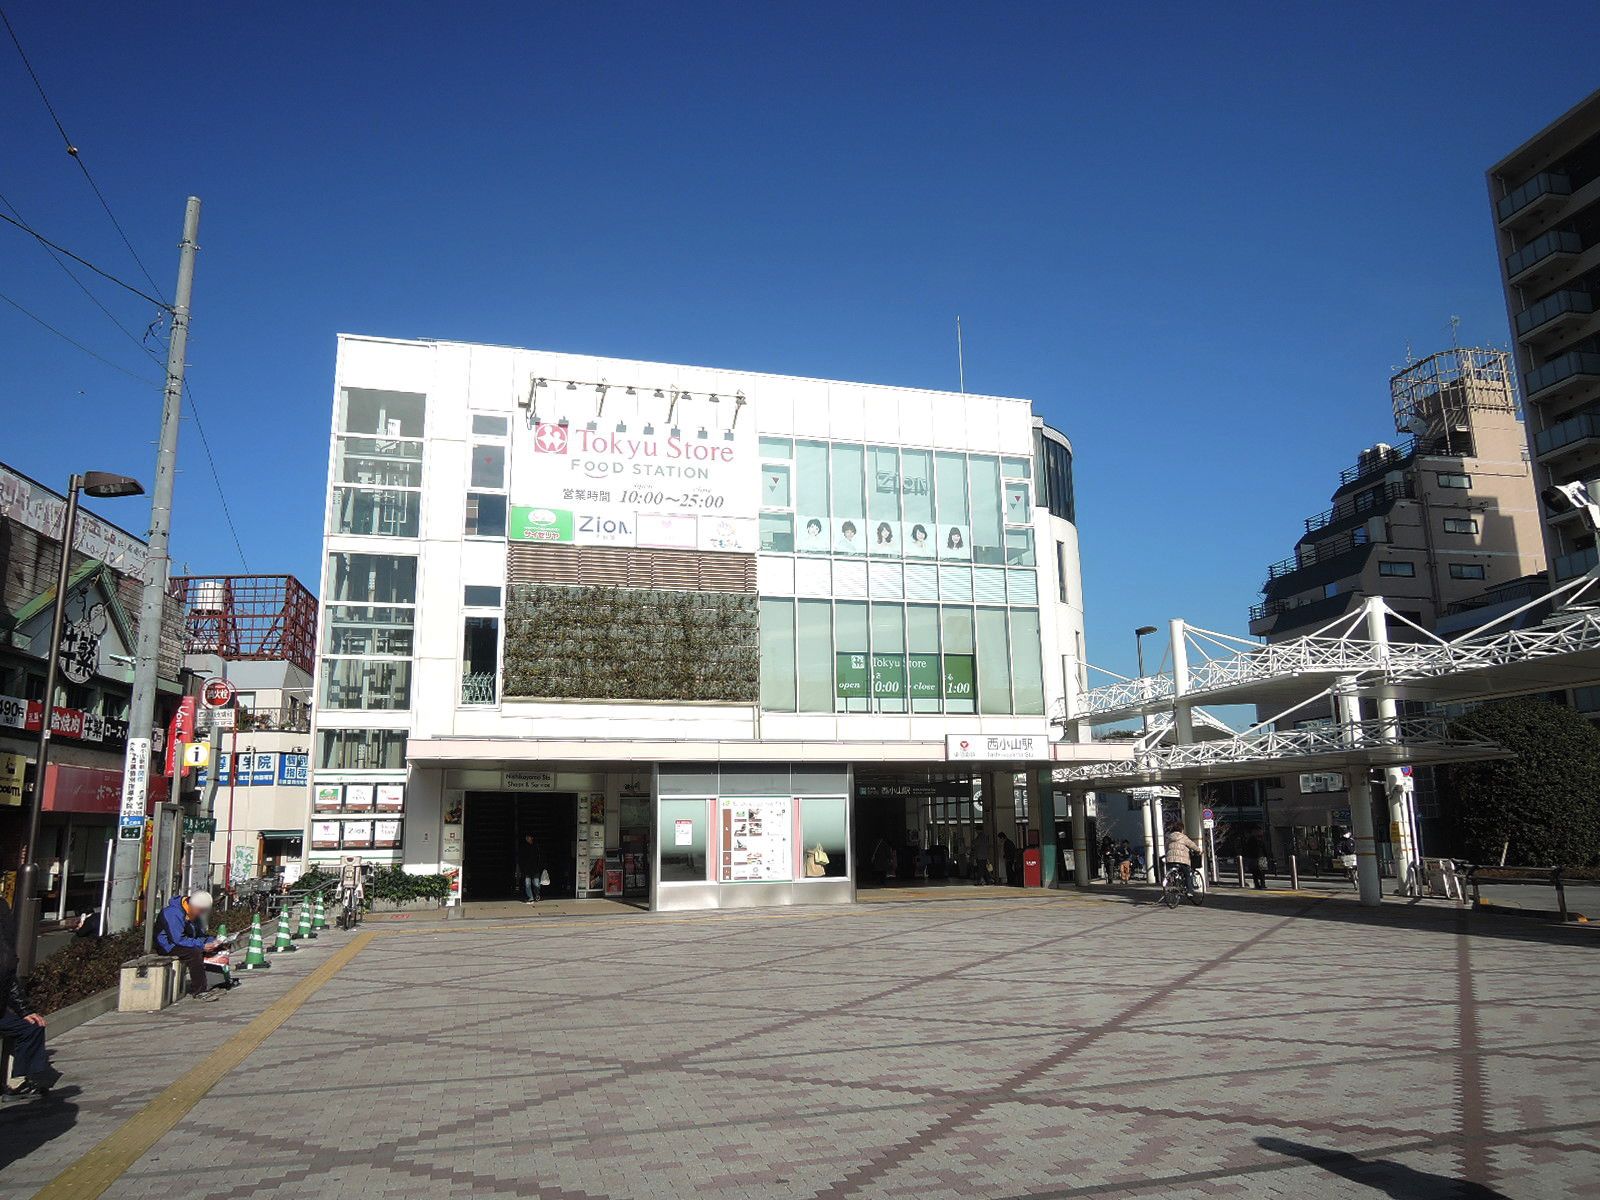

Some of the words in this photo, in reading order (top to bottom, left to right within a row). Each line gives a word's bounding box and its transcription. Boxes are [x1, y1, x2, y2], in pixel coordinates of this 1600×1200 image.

[576, 429, 657, 459] Tokyu
[667, 435, 735, 462] Store
[571, 459, 624, 474] FOOD
[632, 464, 709, 479] STATION
[562, 487, 611, 503] 営業時間
[523, 529, 560, 541] サイゼリヤ
[838, 682, 861, 690] open
[872, 680, 900, 692] 0:00
[913, 682, 936, 690] close
[207, 689, 228, 699] 消火栓
[987, 737, 1033, 751] 西小山駅
